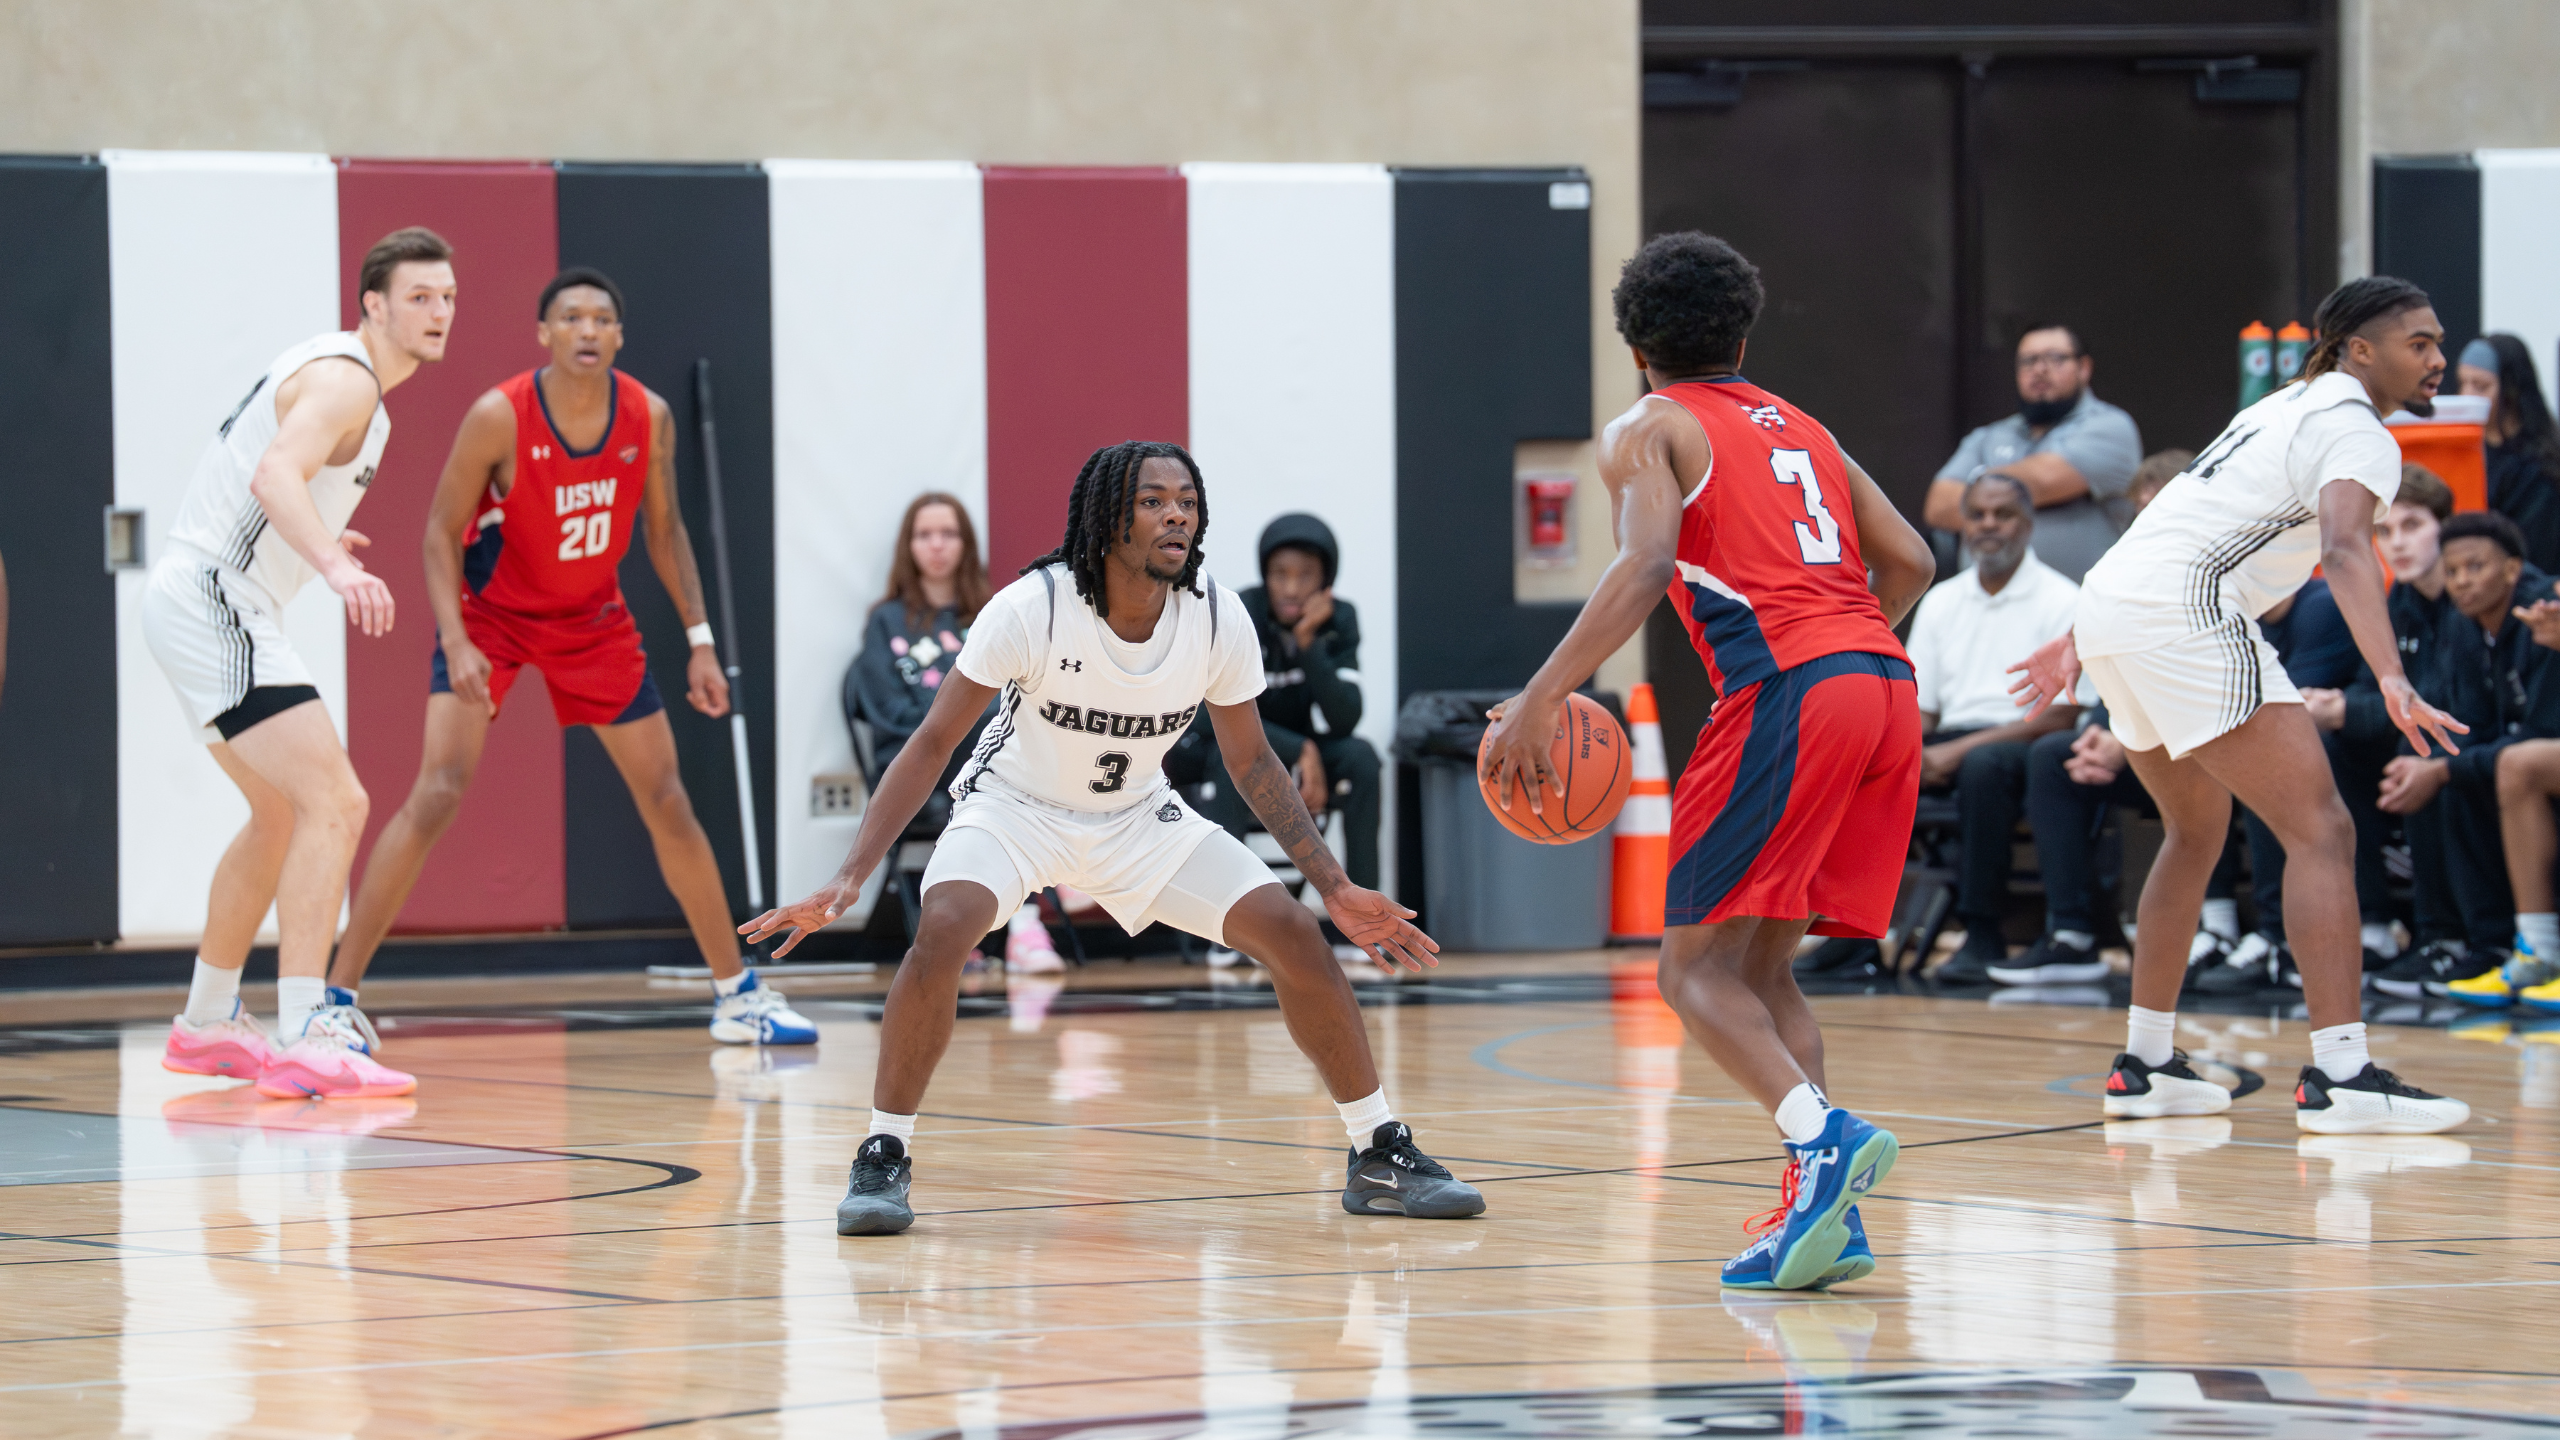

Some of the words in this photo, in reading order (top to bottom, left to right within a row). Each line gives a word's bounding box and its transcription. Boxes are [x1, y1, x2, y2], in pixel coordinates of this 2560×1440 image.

[555, 477, 617, 517] USW
[1768, 447, 1842, 565] 3
[558, 510, 611, 561] 20
[1039, 699, 1197, 739] JAGUARS
[1579, 708, 1591, 759] JAGUARS
[1088, 750, 1132, 794] 3
